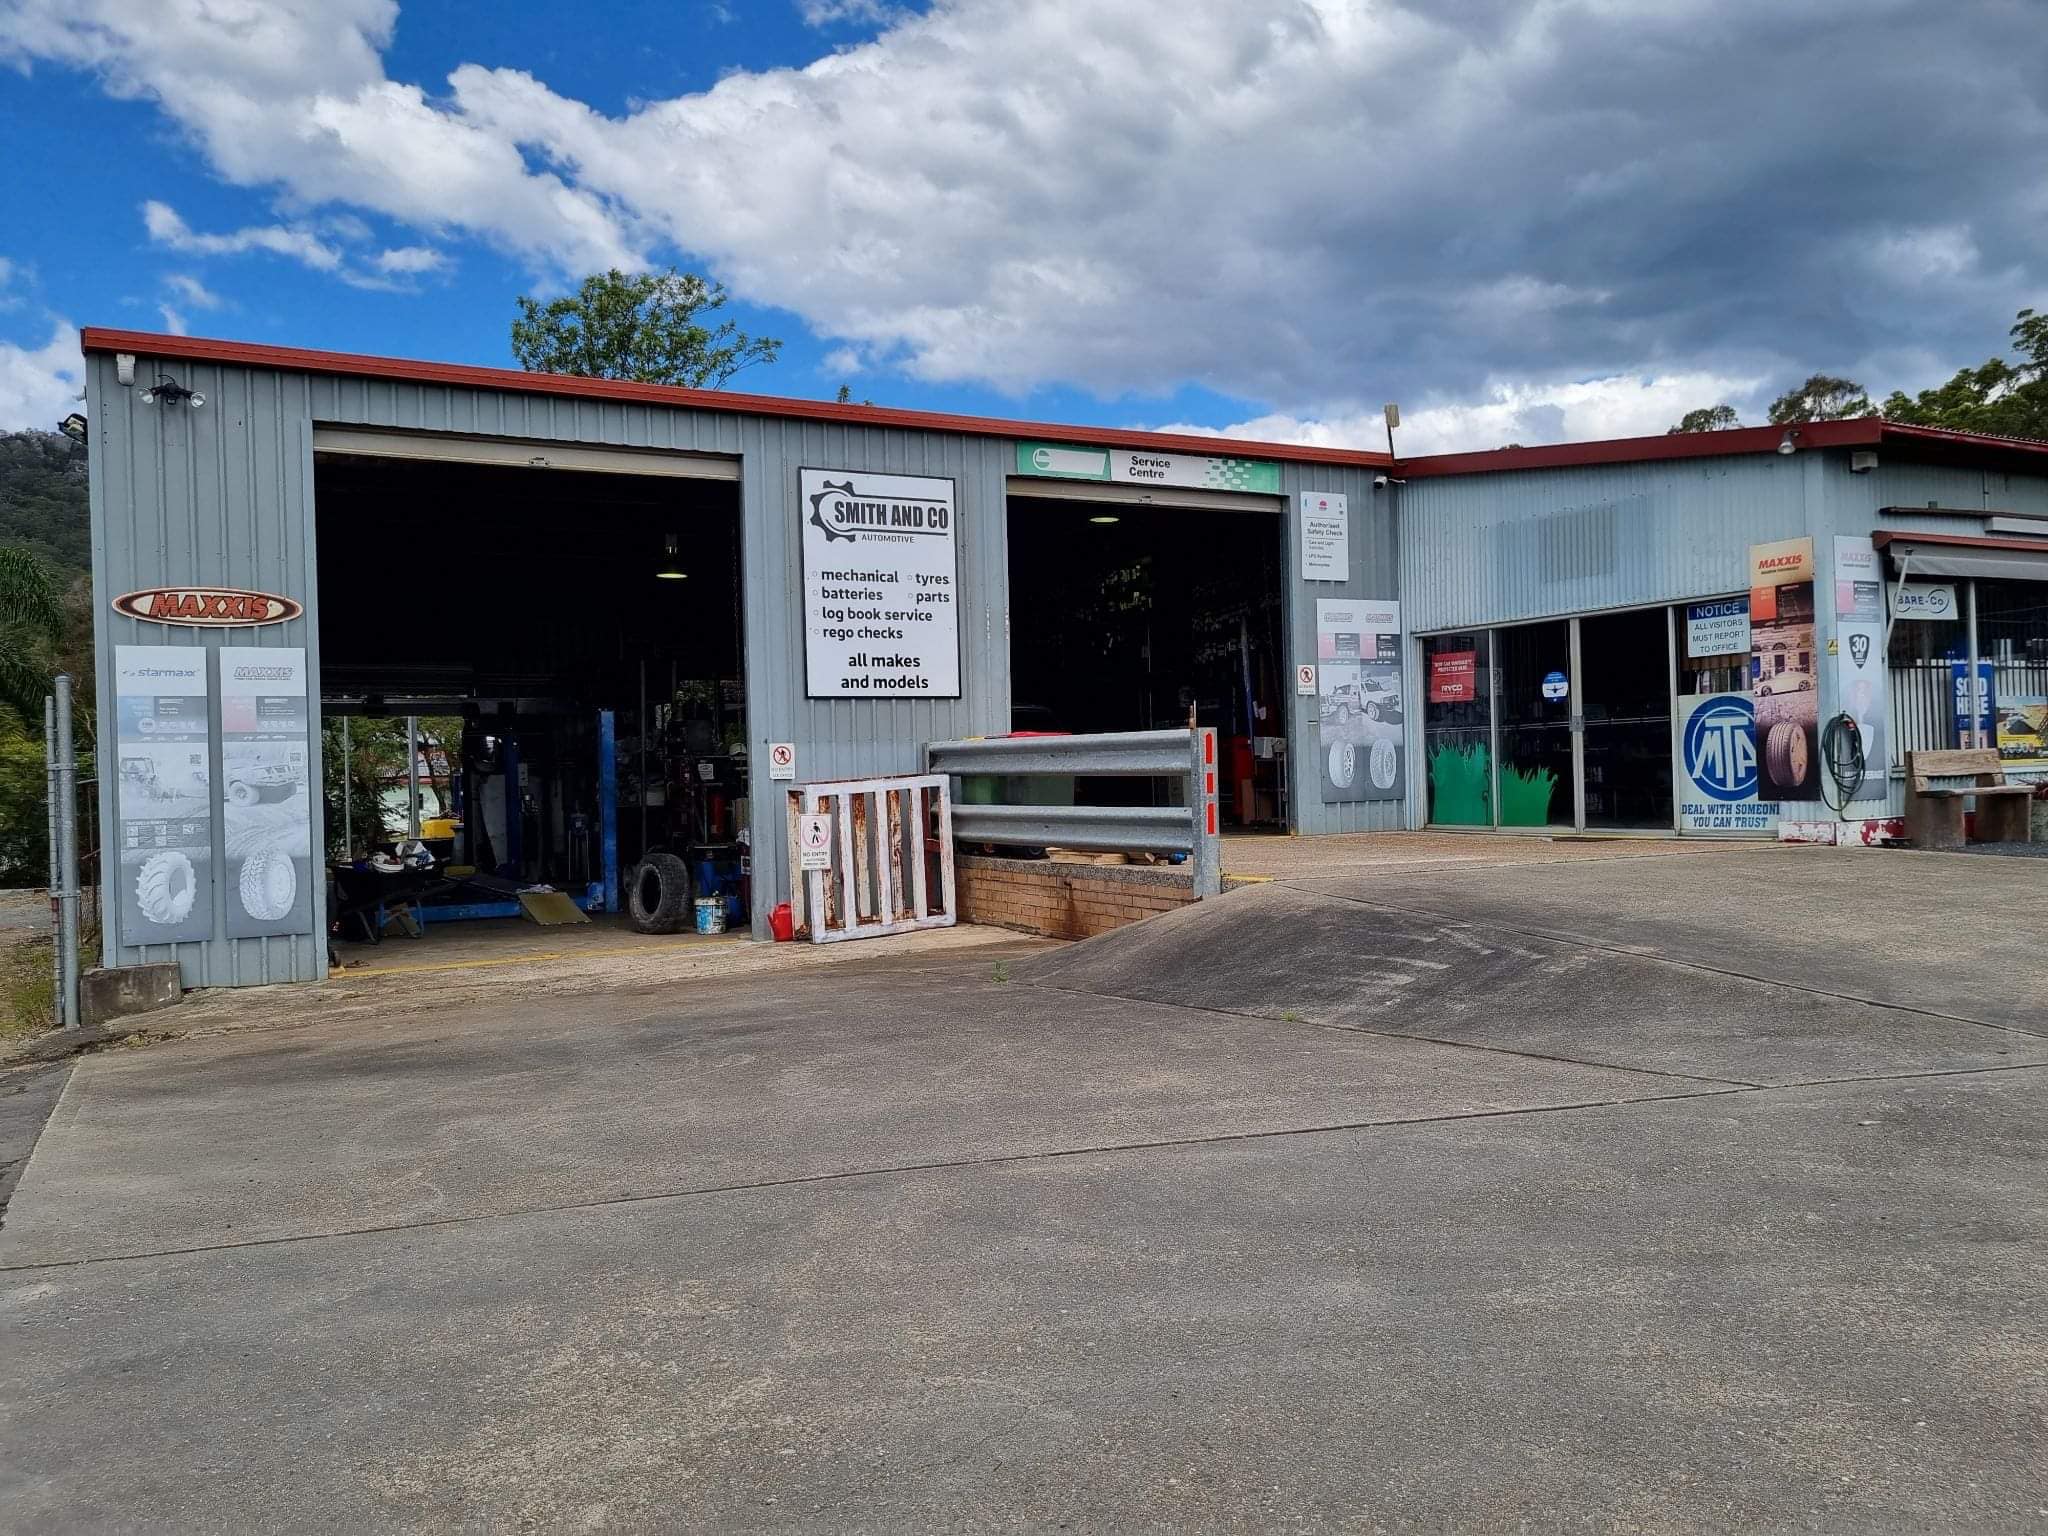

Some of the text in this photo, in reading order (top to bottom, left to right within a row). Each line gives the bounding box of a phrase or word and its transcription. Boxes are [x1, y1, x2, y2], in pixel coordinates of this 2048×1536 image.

[1131, 455, 1171, 468] Service
[1129, 467, 1165, 478] Centre
[834, 501, 949, 529] SMITH AND CO
[861, 534, 915, 543] AUTOMOTIVE
[1758, 554, 1803, 570] MAXXIS
[822, 569, 899, 583] mechanical
[915, 573, 950, 586] tyres
[822, 586, 883, 600] batteries
[916, 592, 950, 605] parts
[149, 592, 269, 620] MAXXIS
[1696, 602, 1740, 618] NOTICE
[822, 606, 933, 622] log book service
[1709, 619, 1743, 629] VISITORS
[823, 626, 903, 641] rego checks
[1692, 631, 1744, 642] MUST REPORT
[1712, 643, 1738, 652] OFFICE
[1852, 636, 1867, 652] 30
[848, 653, 921, 667] all makes
[234, 666, 293, 677] MAXXIS
[841, 674, 929, 688] and models
[1692, 717, 1757, 791] MTA
[1682, 804, 1705, 815] DEAL
[1710, 804, 1733, 814] WITH
[1693, 816, 1768, 827] YOU CAN TRUST
